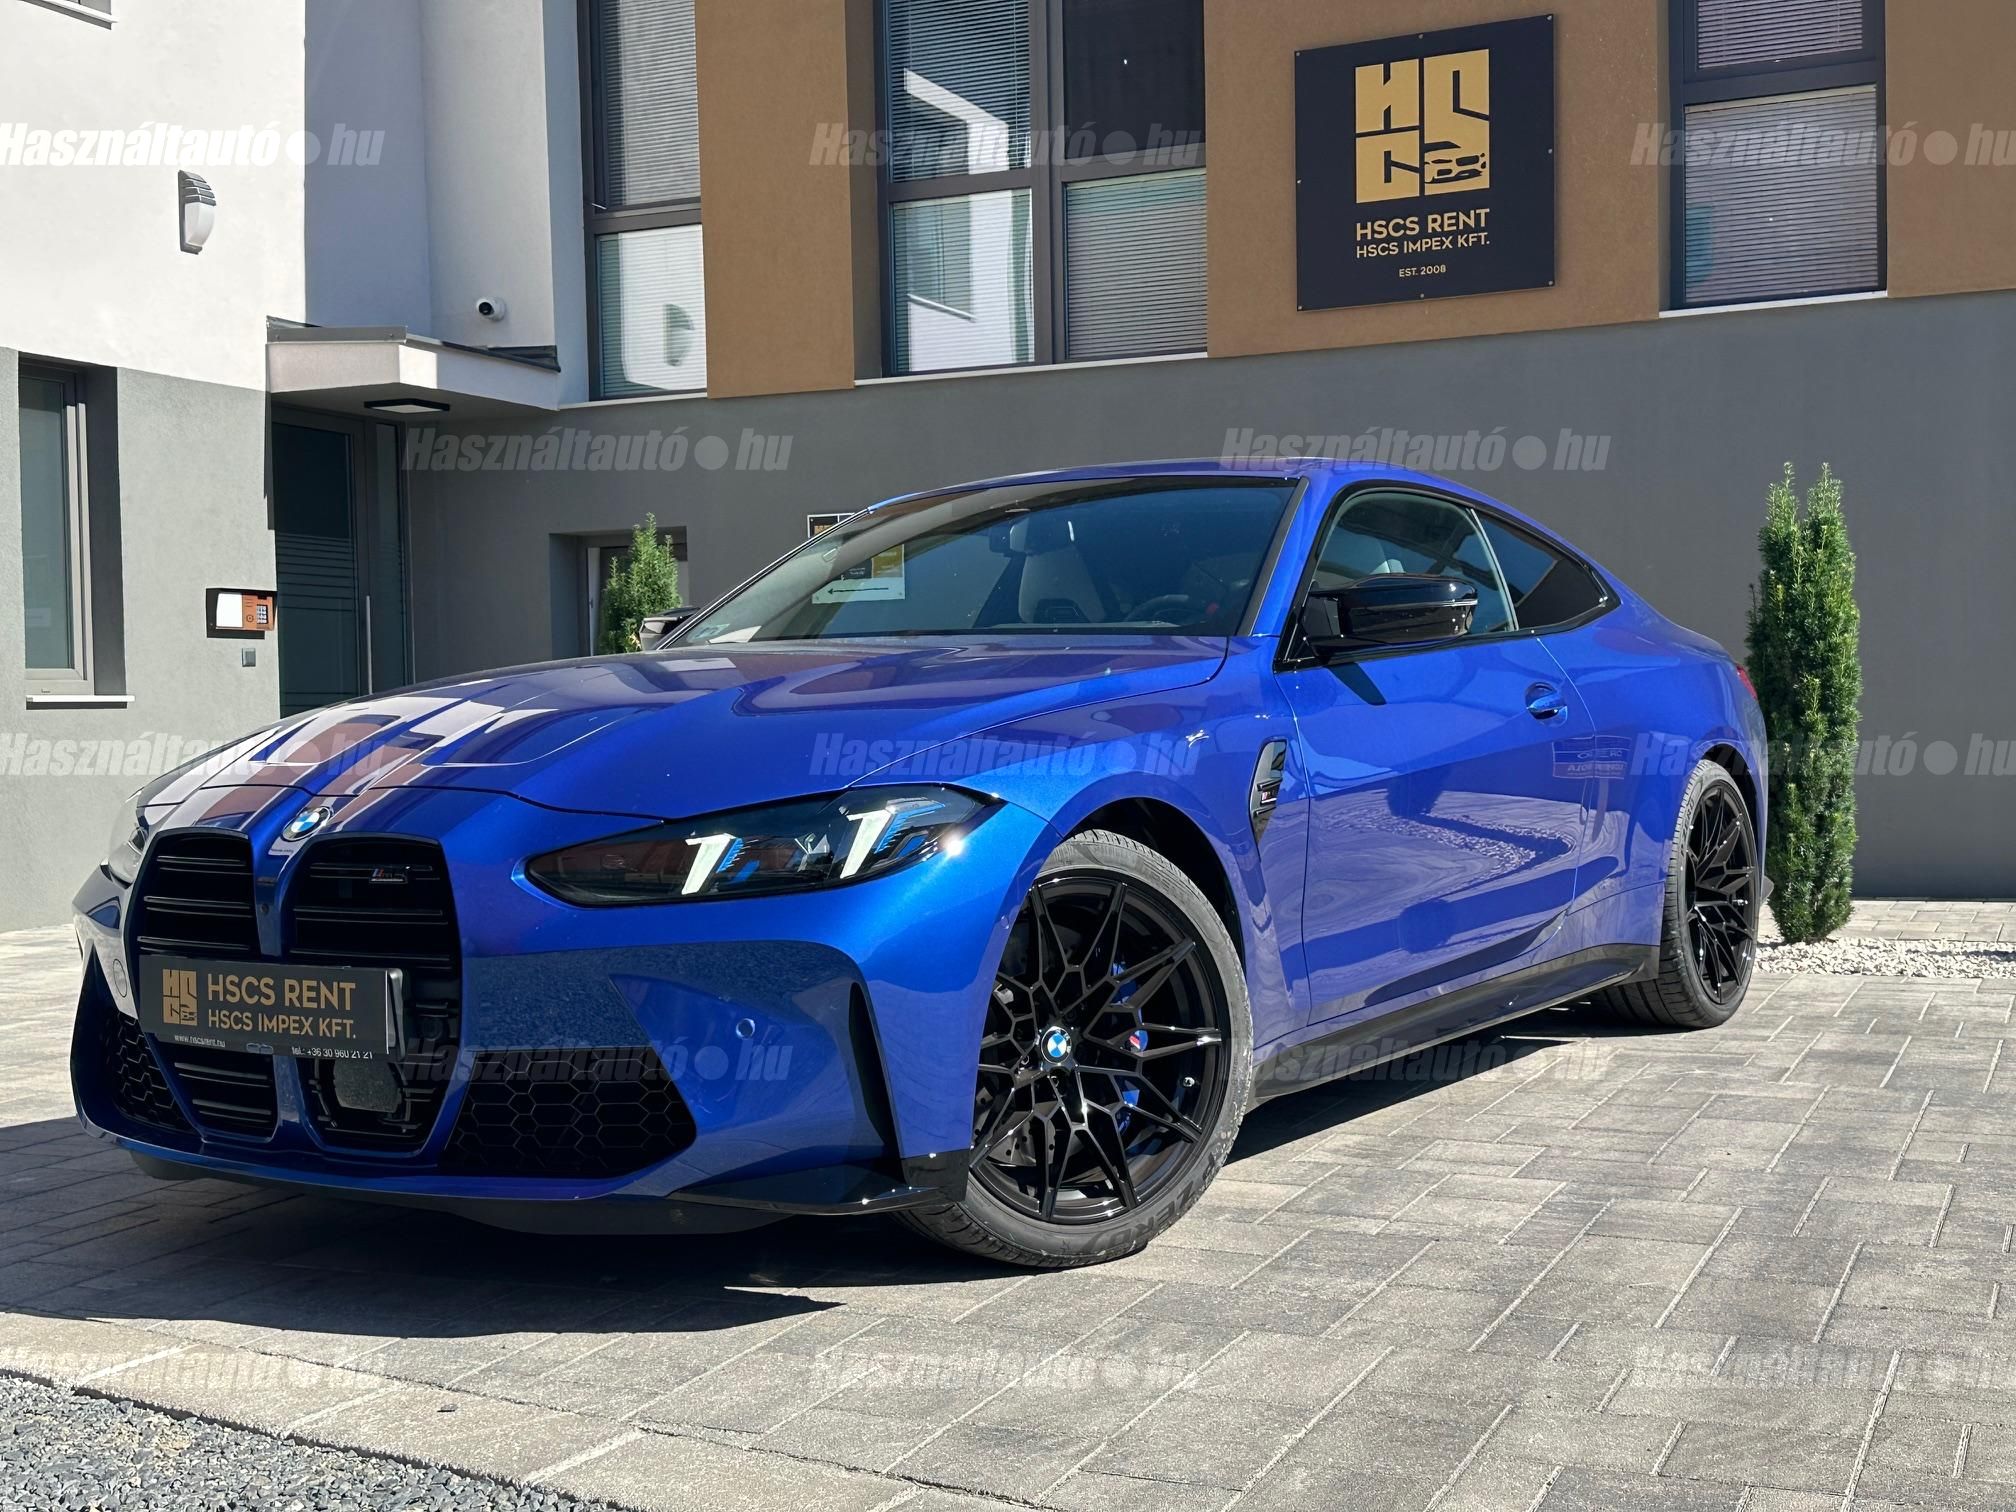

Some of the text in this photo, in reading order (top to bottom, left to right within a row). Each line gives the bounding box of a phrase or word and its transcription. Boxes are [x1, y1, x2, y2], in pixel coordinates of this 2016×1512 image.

[1356, 208, 1490, 242] HSCS RENT
[1356, 232, 1490, 259] HSCS IMPEX KFT.
[1399, 264, 1447, 278] EST. 2008
[207, 973, 356, 1011] HSCS RENT
[208, 1009, 357, 1039] HSCS IMPEX KFT.
[323, 1047, 333, 1058] 30
